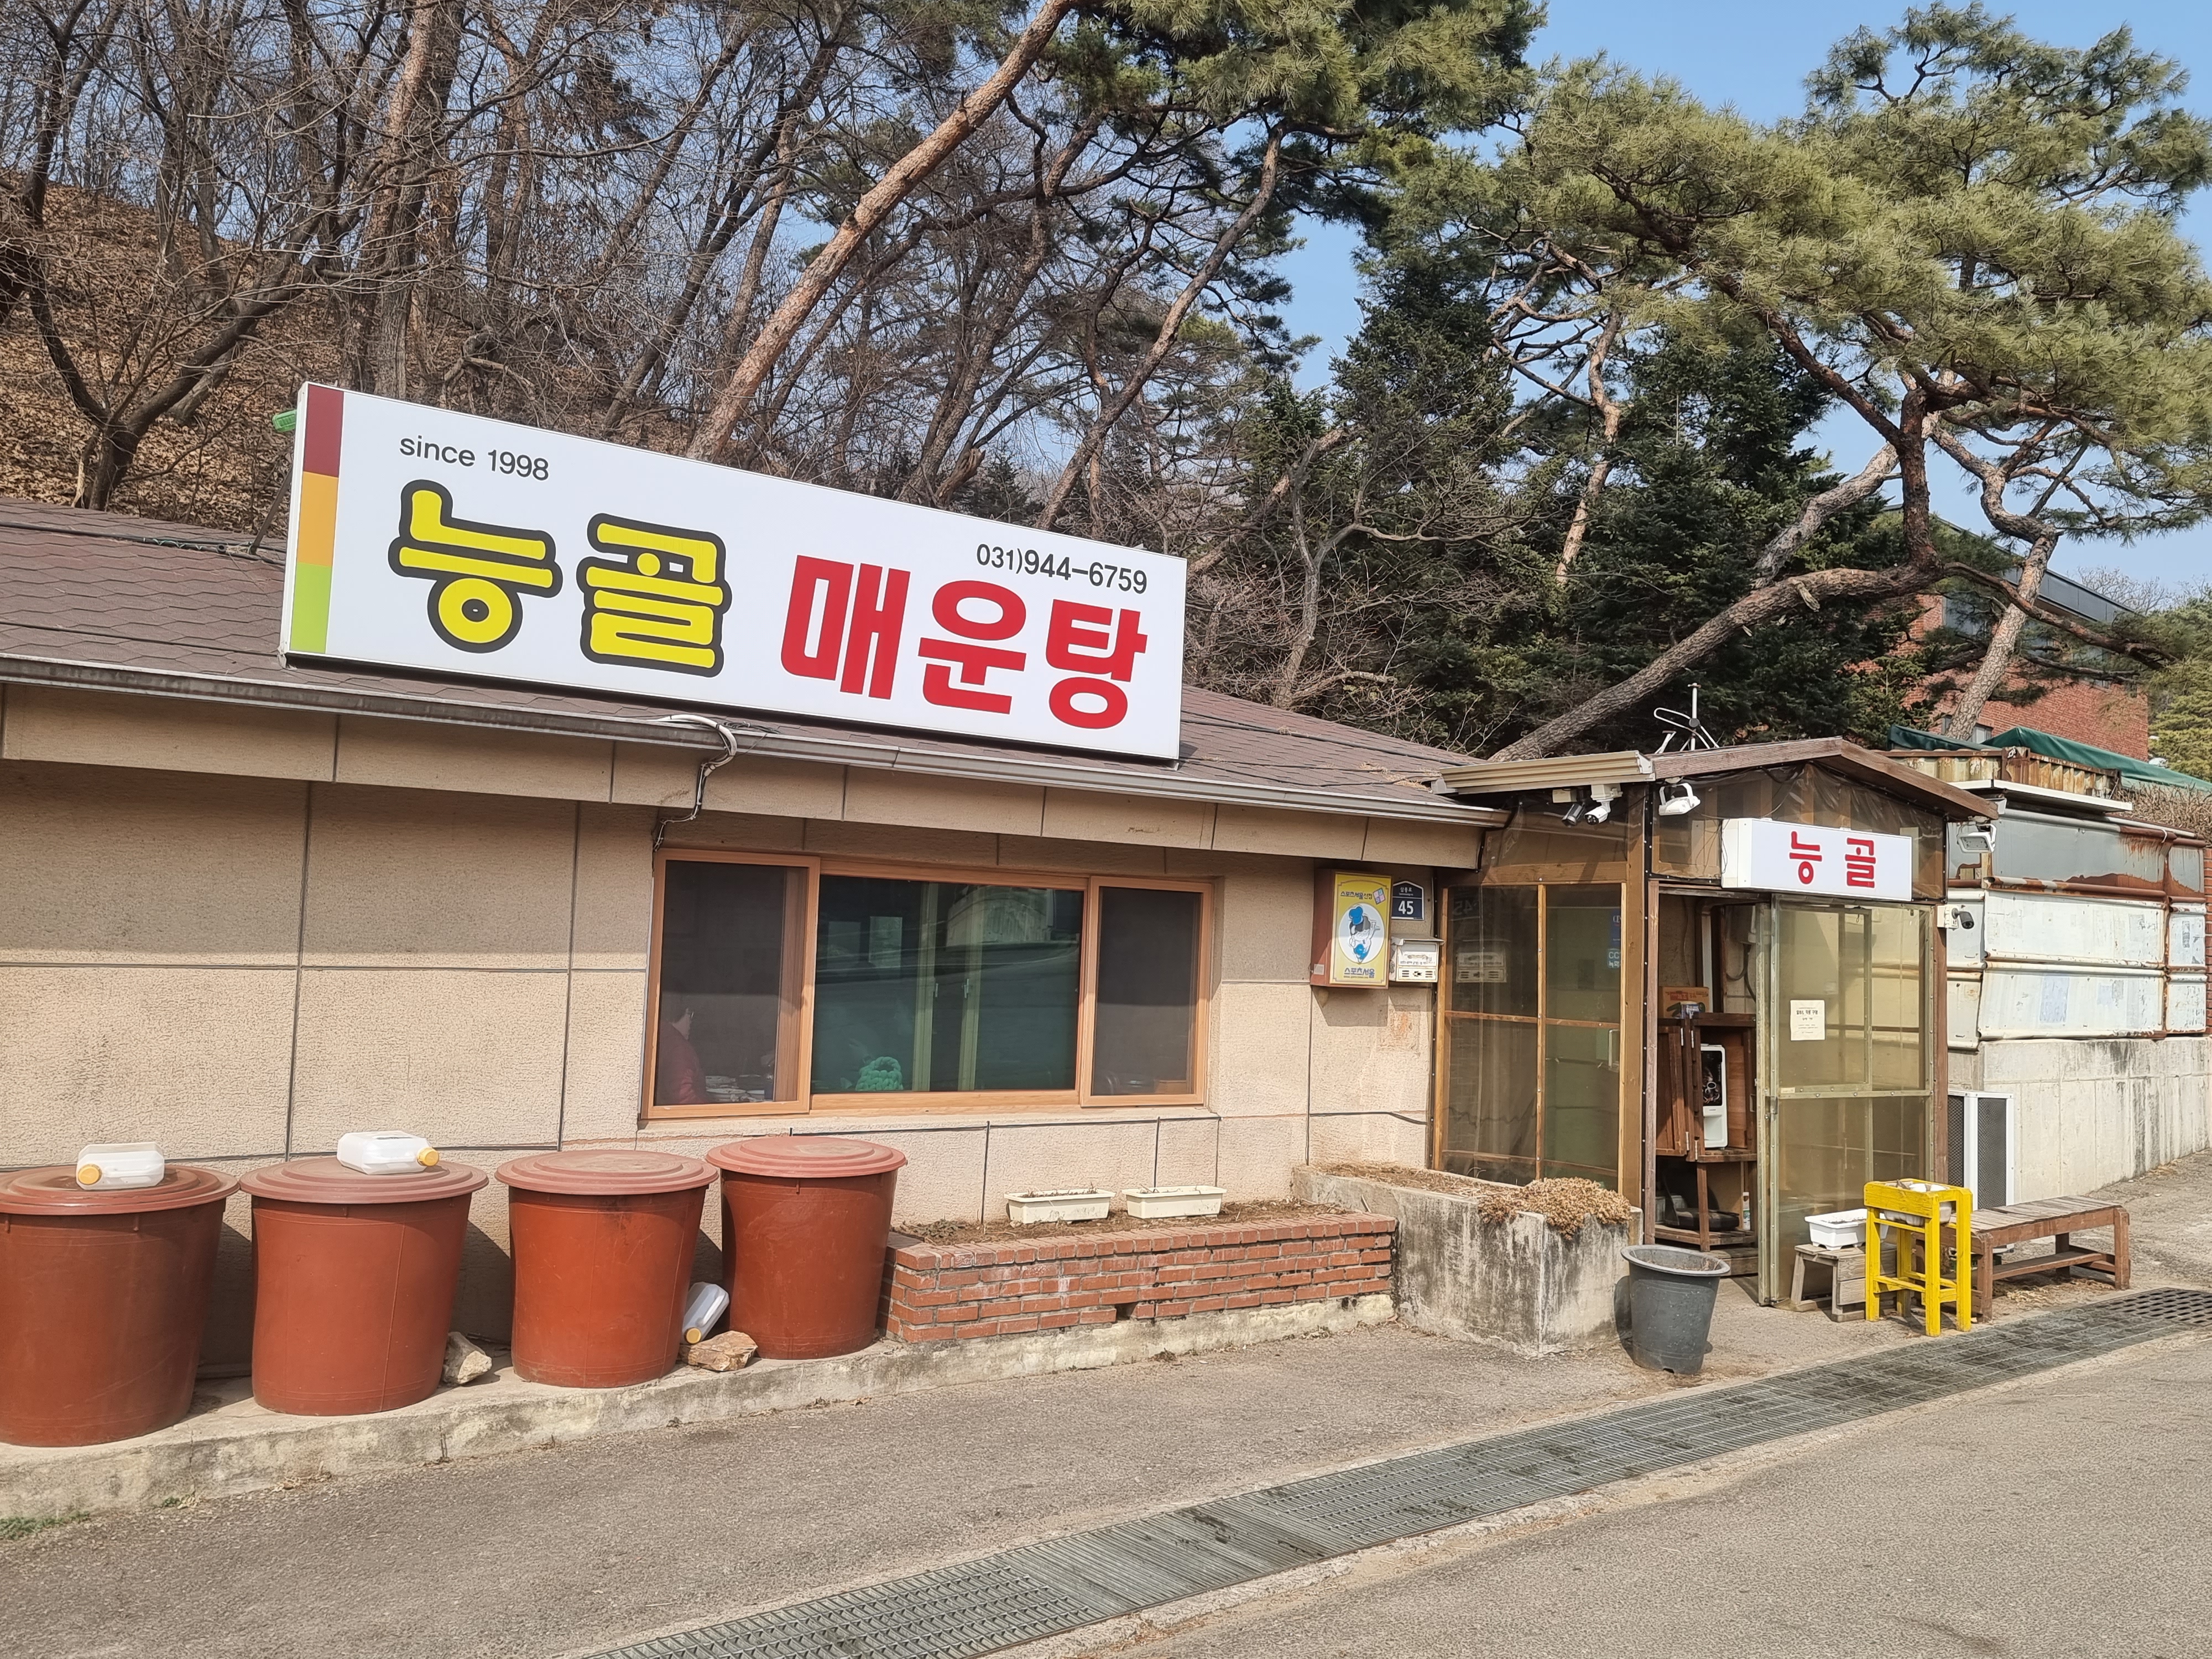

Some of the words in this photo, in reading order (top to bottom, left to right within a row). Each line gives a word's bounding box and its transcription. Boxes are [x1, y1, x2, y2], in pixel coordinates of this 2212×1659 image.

[399, 435, 476, 467] since
[488, 450, 549, 481] 1998
[977, 544, 1147, 594] 031)944-6759
[388, 479, 733, 678] 능골
[781, 555, 1148, 729] 매운탕
[1789, 831, 1876, 889] 능골
[1398, 900, 1414, 915] 45
[1344, 967, 1375, 978] 스포츠서울
